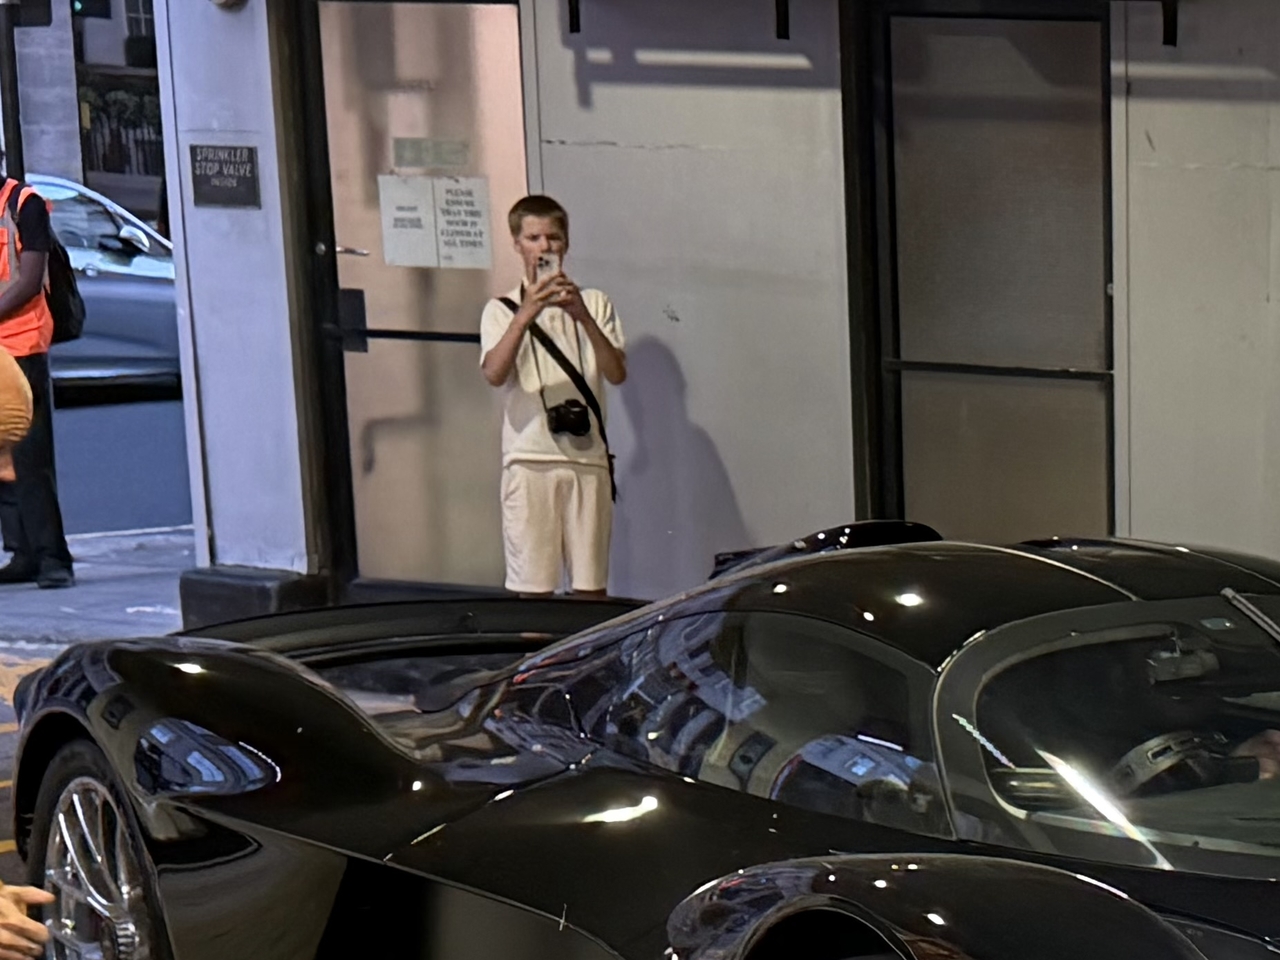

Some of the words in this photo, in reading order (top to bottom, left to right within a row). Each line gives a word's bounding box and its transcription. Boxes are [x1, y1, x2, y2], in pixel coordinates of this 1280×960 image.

[196, 148, 249, 163] SPRINKLER
[194, 161, 220, 176] STOP
[222, 162, 252, 178] VALVE
